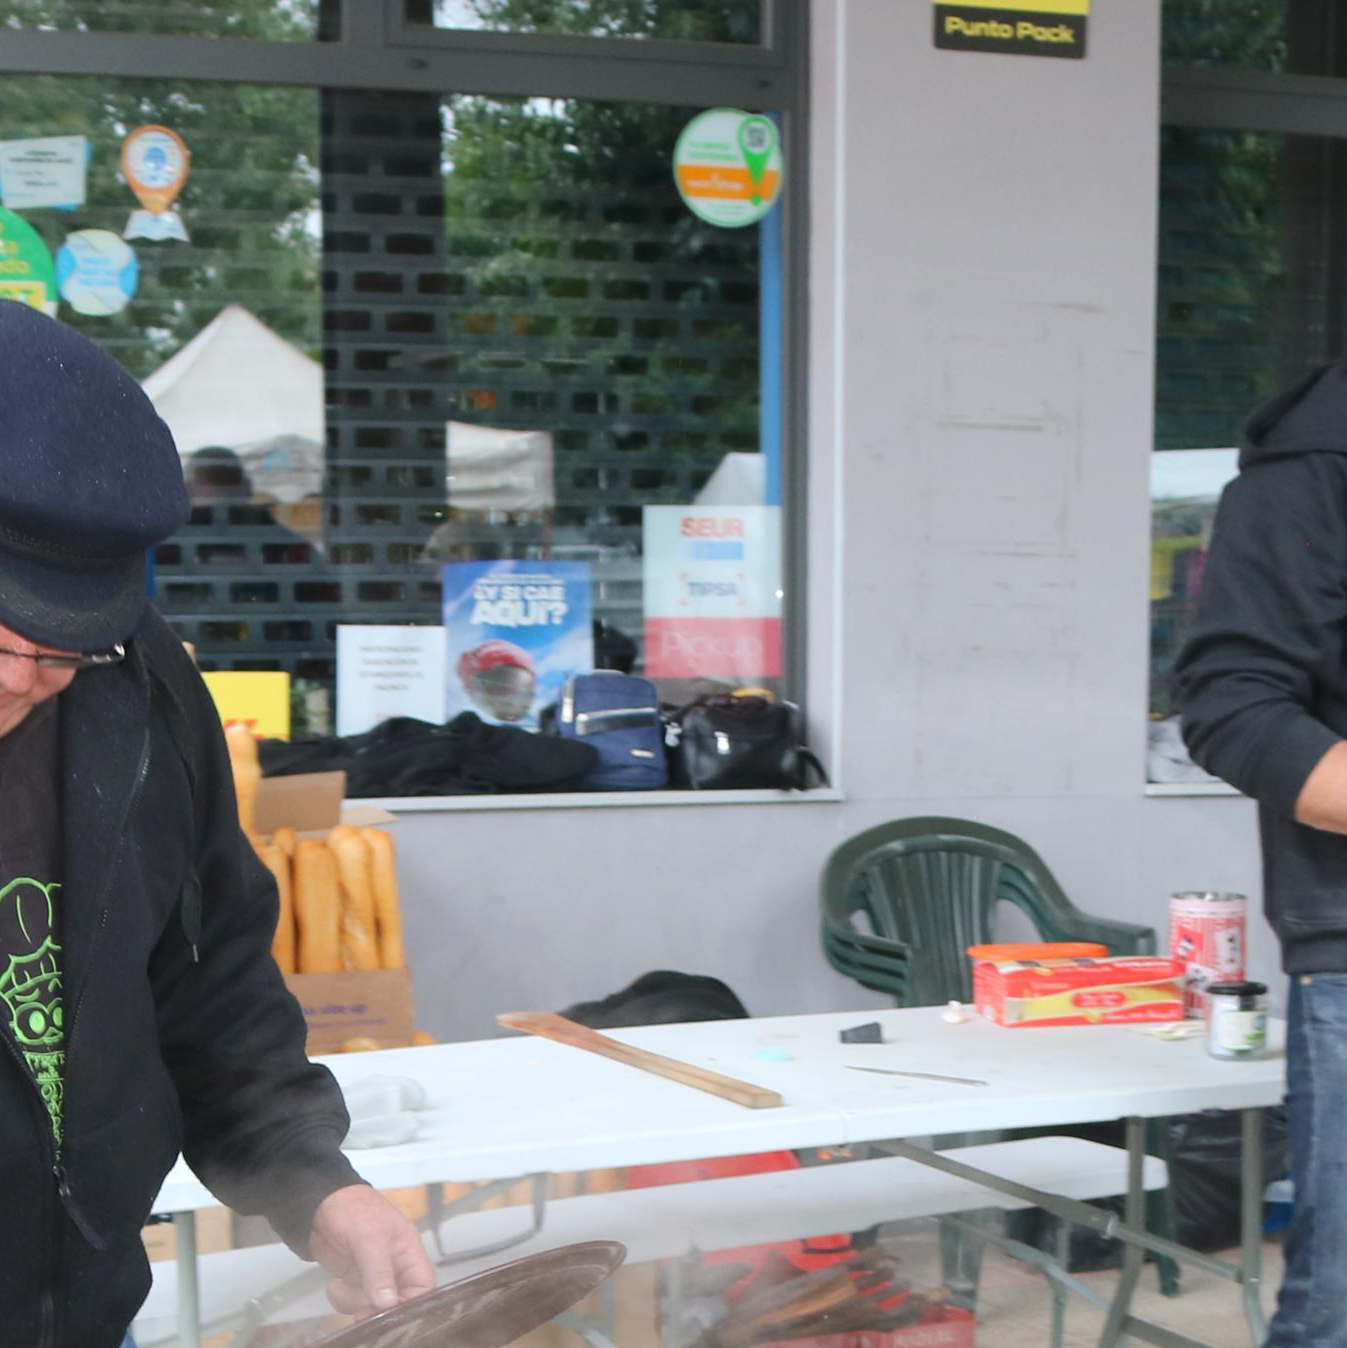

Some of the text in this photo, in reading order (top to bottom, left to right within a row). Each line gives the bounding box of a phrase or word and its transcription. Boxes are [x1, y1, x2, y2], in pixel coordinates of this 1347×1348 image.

[944, 16, 1075, 43] Punto Pack
[681, 517, 744, 537] SEUR
[500, 585, 521, 600] SI
[523, 585, 565, 600] CAE
[687, 581, 739, 597] TIPSA
